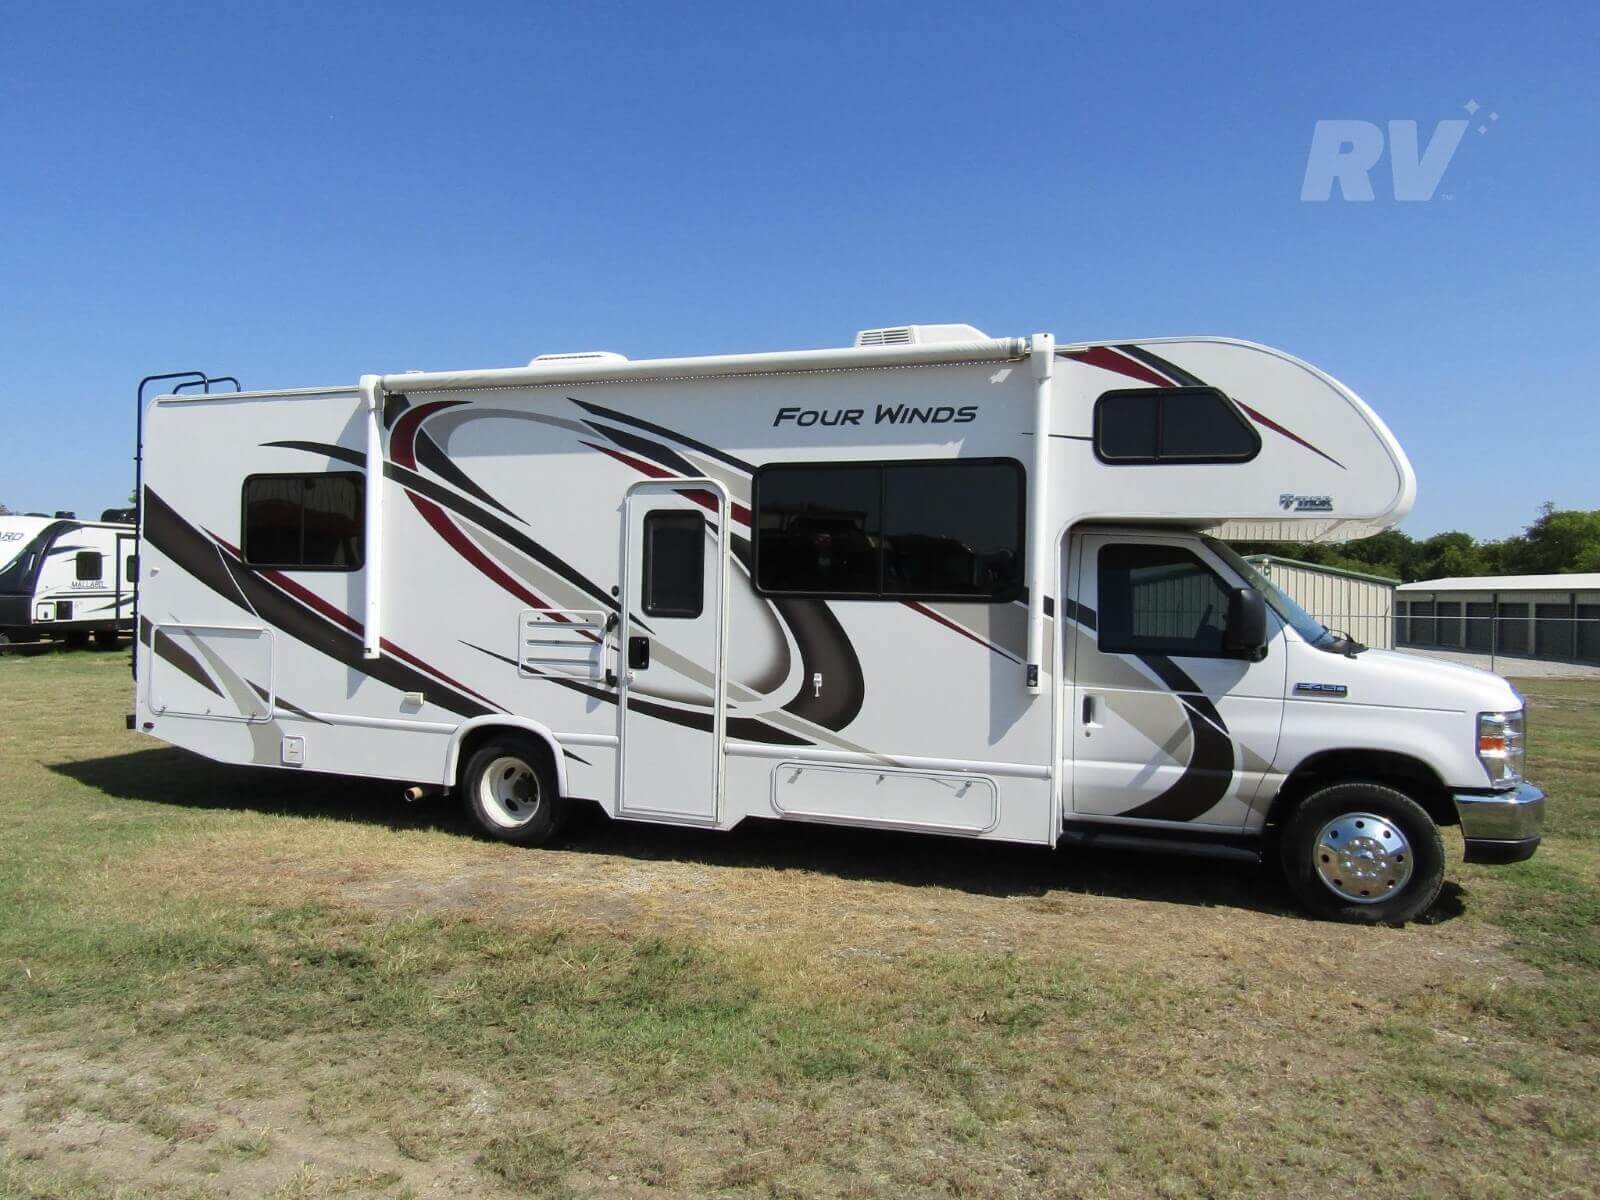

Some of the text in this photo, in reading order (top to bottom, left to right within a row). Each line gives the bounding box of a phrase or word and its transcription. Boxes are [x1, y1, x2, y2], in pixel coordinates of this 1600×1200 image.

[773, 404, 978, 427] FOUR WINDS
[0, 531, 24, 541] RD
